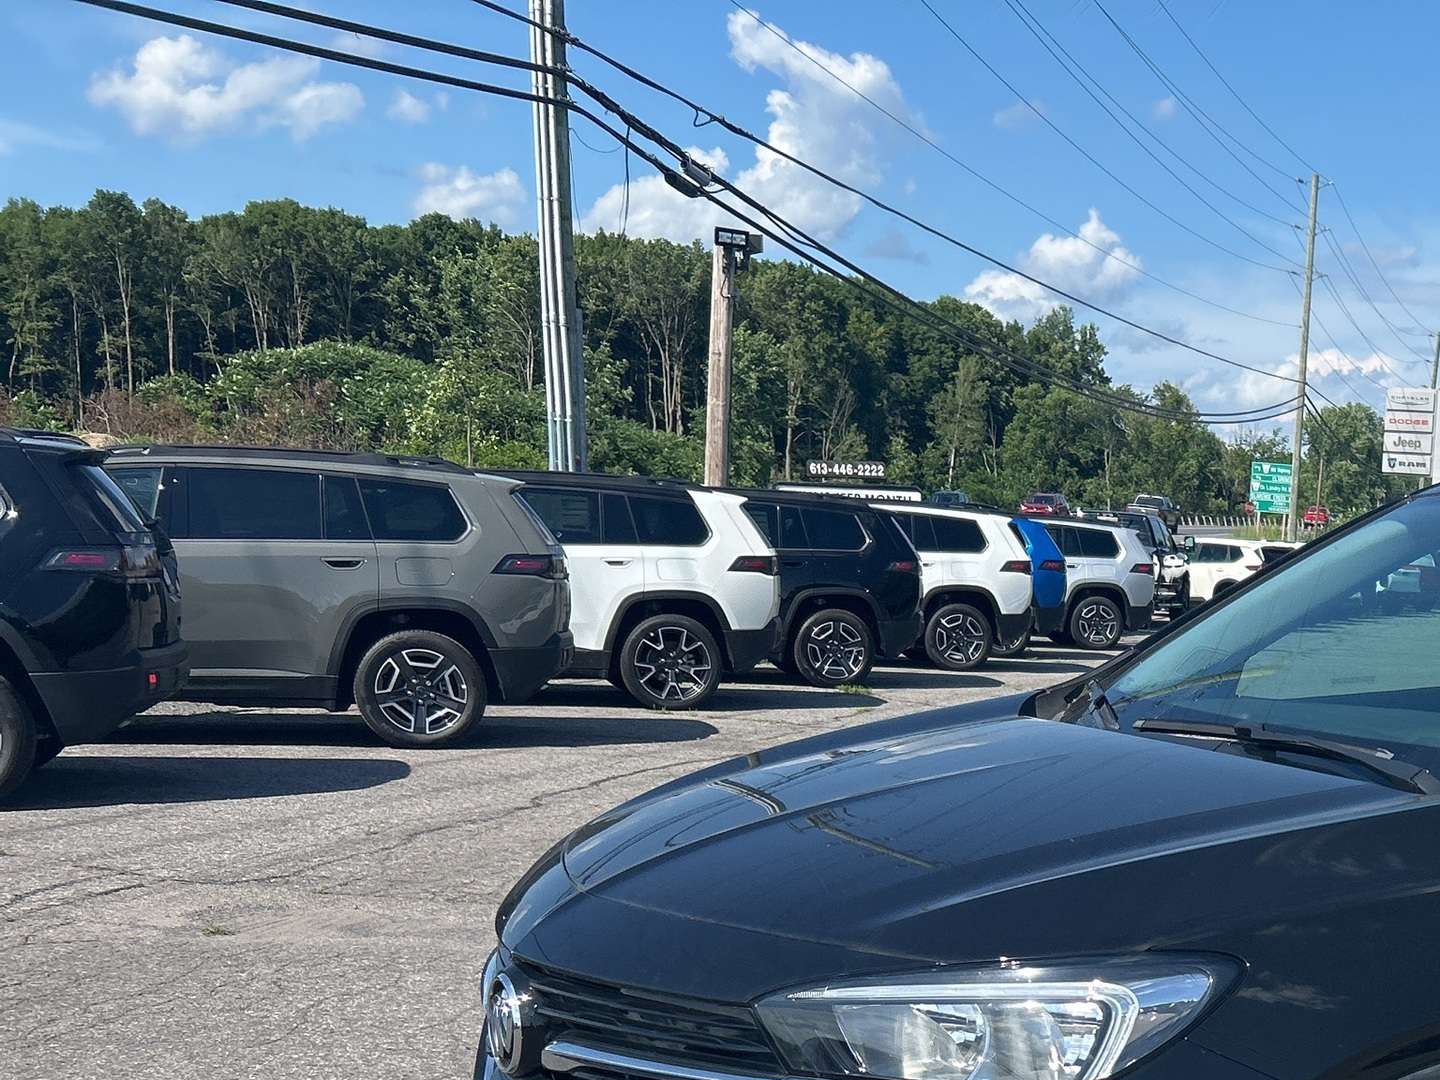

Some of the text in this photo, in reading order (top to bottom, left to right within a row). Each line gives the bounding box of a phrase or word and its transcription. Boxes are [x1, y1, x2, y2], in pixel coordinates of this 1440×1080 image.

[1389, 418, 1429, 426] DODGE
[1393, 436, 1422, 450] Jeep
[809, 462, 885, 477] 613-446-2222
[1398, 460, 1427, 468] RAM
